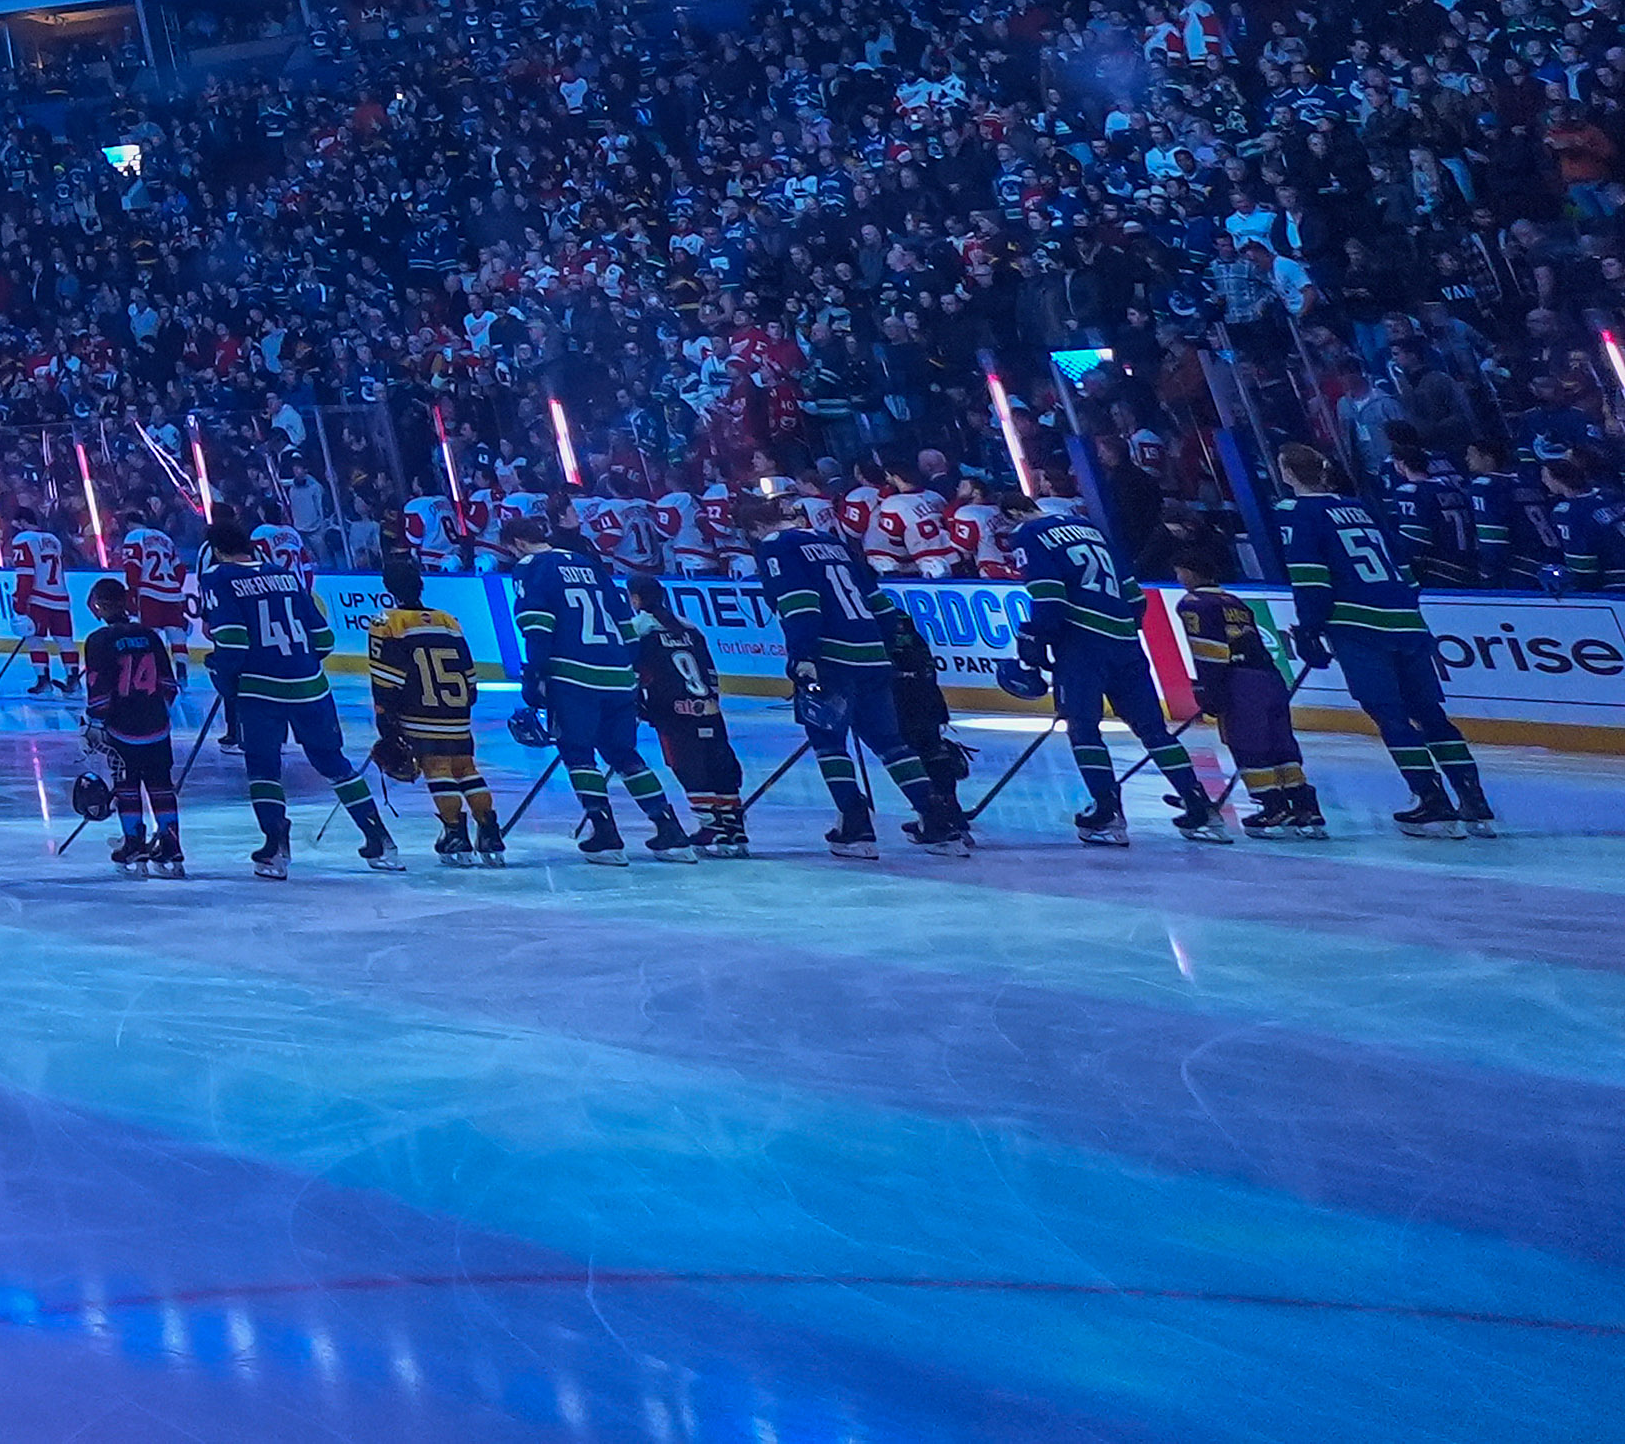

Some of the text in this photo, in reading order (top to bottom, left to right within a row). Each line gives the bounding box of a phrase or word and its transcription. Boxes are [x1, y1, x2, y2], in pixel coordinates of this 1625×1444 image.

[230, 574, 301, 598] SHERWOOD
[338, 592, 364, 608] UP
[1065, 543, 1122, 600] 29
[257, 595, 310, 657] 44
[412, 646, 470, 709] 15
